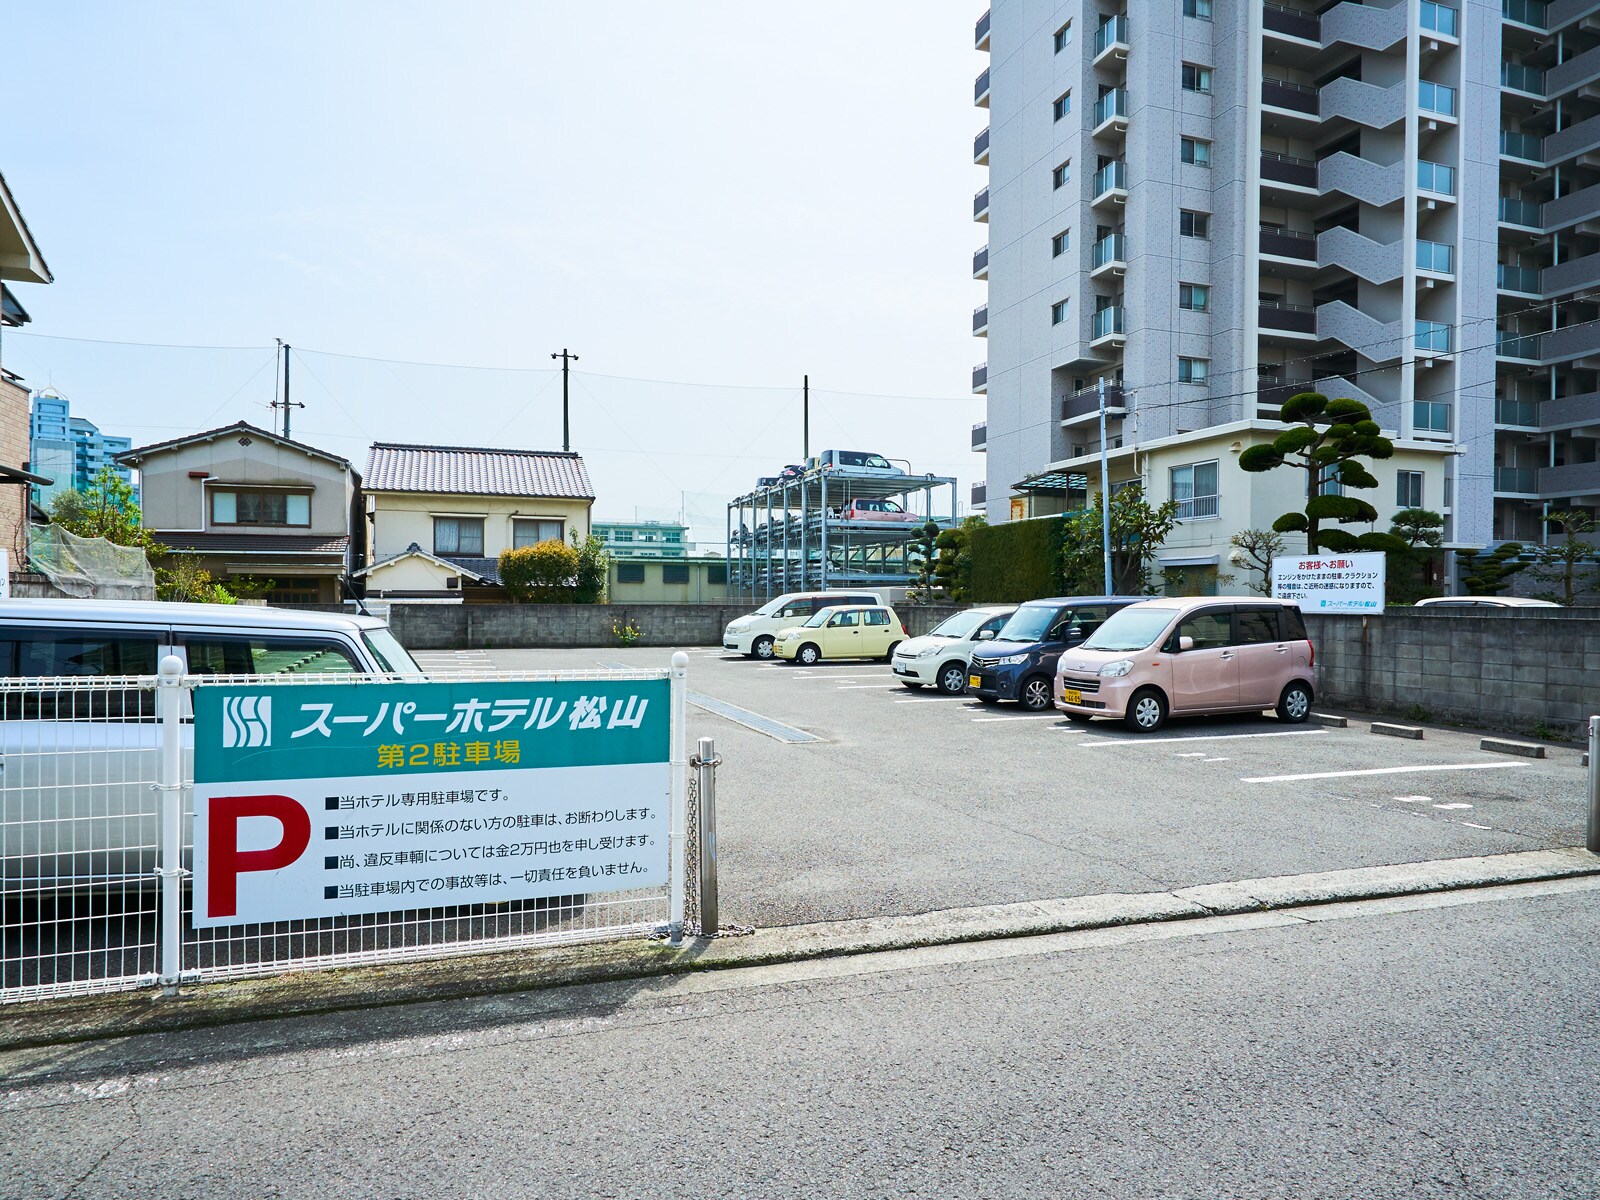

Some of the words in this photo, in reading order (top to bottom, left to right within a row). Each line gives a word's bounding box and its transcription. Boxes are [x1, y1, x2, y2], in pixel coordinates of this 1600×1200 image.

[1278, 572, 1378, 580] エンジンをかけたままの駐車、クラクション
[1298, 560, 1354, 570] お客様へお願い
[291, 695, 649, 738] スーパーホテル松山
[377, 740, 521, 769] 第2駐車場
[340, 788, 509, 810] 当ホテル専用駐車場です。
[340, 808, 656, 840] 当ホテルに関係のない方の駐車は、お断わりします。
[207, 794, 311, 918] P
[340, 834, 655, 869] 尚、違反車輌については金2万円也を申し受けます。
[340, 862, 649, 899] 当駐車場内での事故等は、一切責任を負いません。
